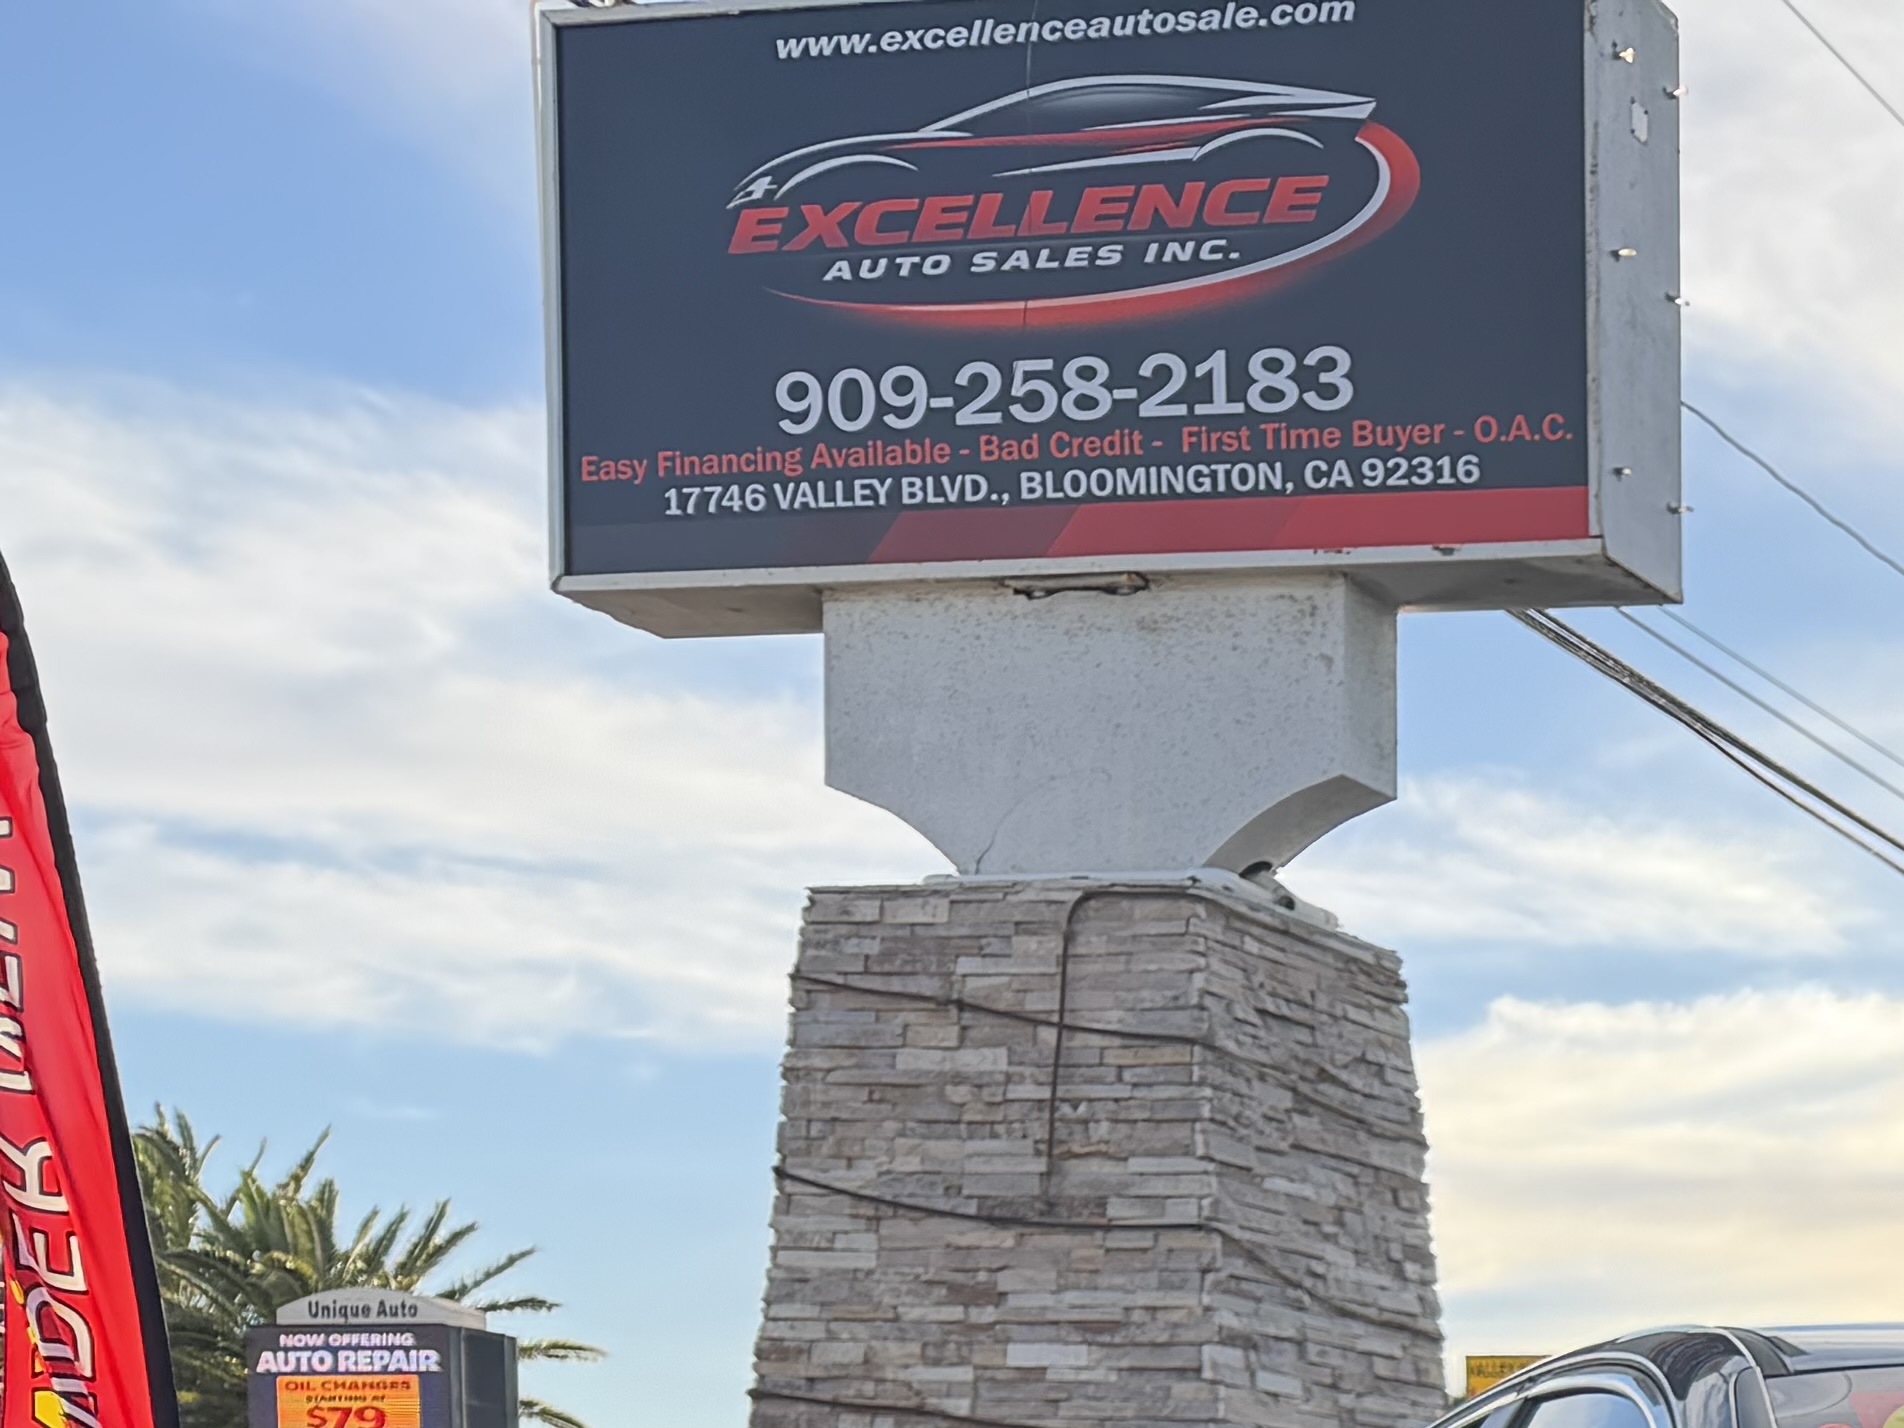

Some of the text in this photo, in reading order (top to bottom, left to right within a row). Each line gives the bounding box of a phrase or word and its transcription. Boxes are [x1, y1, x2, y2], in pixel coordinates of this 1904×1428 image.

[775, 0, 1355, 58] www.excellenceautosale.com
[727, 176, 1329, 255] EXCELLENCE
[823, 239, 1241, 282] AUTO SALES INC.
[775, 345, 1354, 435] 909-258-2183
[581, 456, 647, 484] Easy
[658, 447, 803, 479] Financing
[811, 438, 951, 470] Available
[980, 433, 1039, 463] Bad
[1049, 430, 1143, 460] Credit
[1182, 424, 1251, 455] First
[1260, 420, 1342, 452] Time
[1352, 418, 1446, 452] Buyer
[1474, 413, 1574, 444] O.A.C.
[664, 454, 1482, 516] 17746 VALLEY BLVD., BLOOMINGTON, CA 92316
[308, 1299, 418, 1323] Unique Auto
[256, 1349, 443, 1373] AUTO REPAIR
[279, 1332, 416, 1347] NOW OFFERING
[284, 1379, 411, 1392] OIL CHANGES
